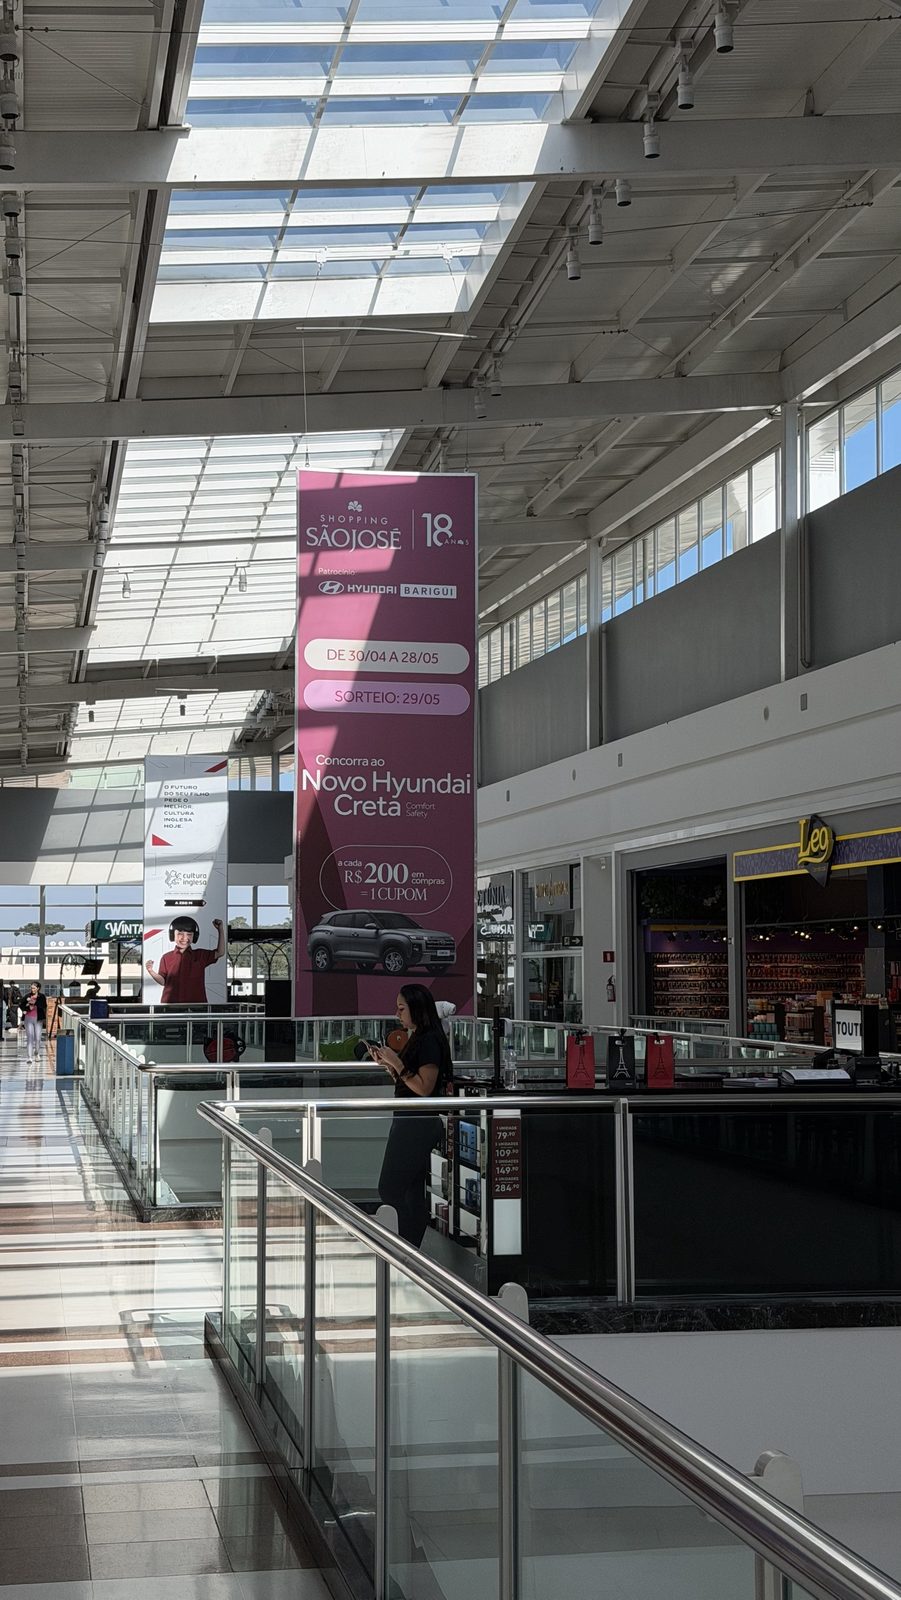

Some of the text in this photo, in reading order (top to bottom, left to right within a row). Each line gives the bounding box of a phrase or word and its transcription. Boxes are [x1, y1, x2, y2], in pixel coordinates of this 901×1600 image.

[320, 514, 389, 525] SHOPPING
[421, 513, 453, 547] 18
[347, 584, 397, 595] HYUNDAI
[327, 649, 439, 664] DE 30/04 A 28/05
[335, 691, 440, 705] SORTEIO: 29/05
[315, 754, 385, 767] Concorra ao
[302, 769, 471, 799] Novo Hyundai
[334, 793, 401, 817] Creta
[405, 801, 435, 810] Comfort
[405, 810, 428, 819] Safety
[343, 859, 362, 867] cada
[344, 862, 409, 885] R$ 200
[182, 879, 207, 887] inglesa
[411, 877, 445, 886] compras
[377, 888, 428, 901] CUPOM
